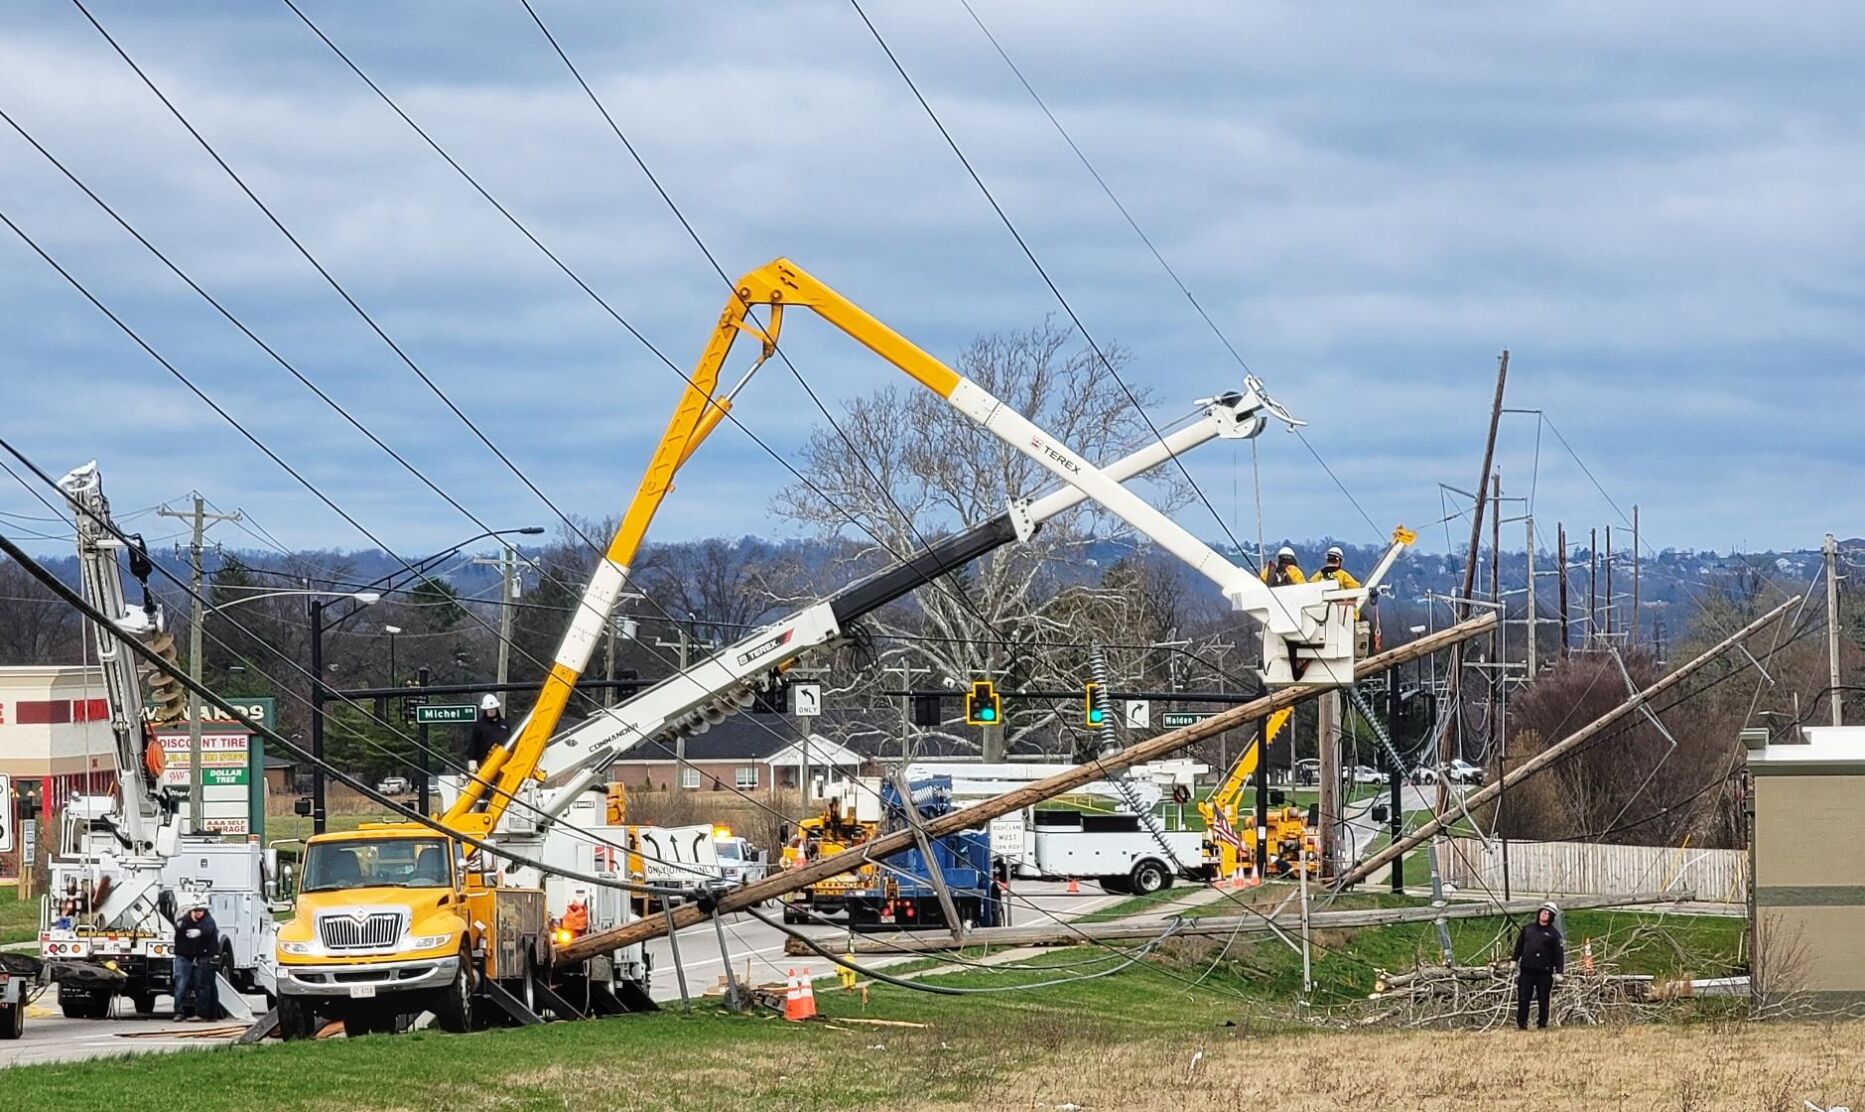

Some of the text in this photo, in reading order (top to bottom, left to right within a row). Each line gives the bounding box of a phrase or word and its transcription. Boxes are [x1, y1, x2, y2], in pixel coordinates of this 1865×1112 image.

[1044, 445, 1081, 475] TEREX
[748, 640, 778, 659] TEREX
[425, 709, 460, 718] Michel
[1165, 716, 1193, 725] Walden
[588, 722, 639, 752] COMMANDER
[160, 738, 246, 747] DISCONT TIRE
[209, 769, 242, 777] DOLLAR
[648, 866, 666, 875] ONLY
